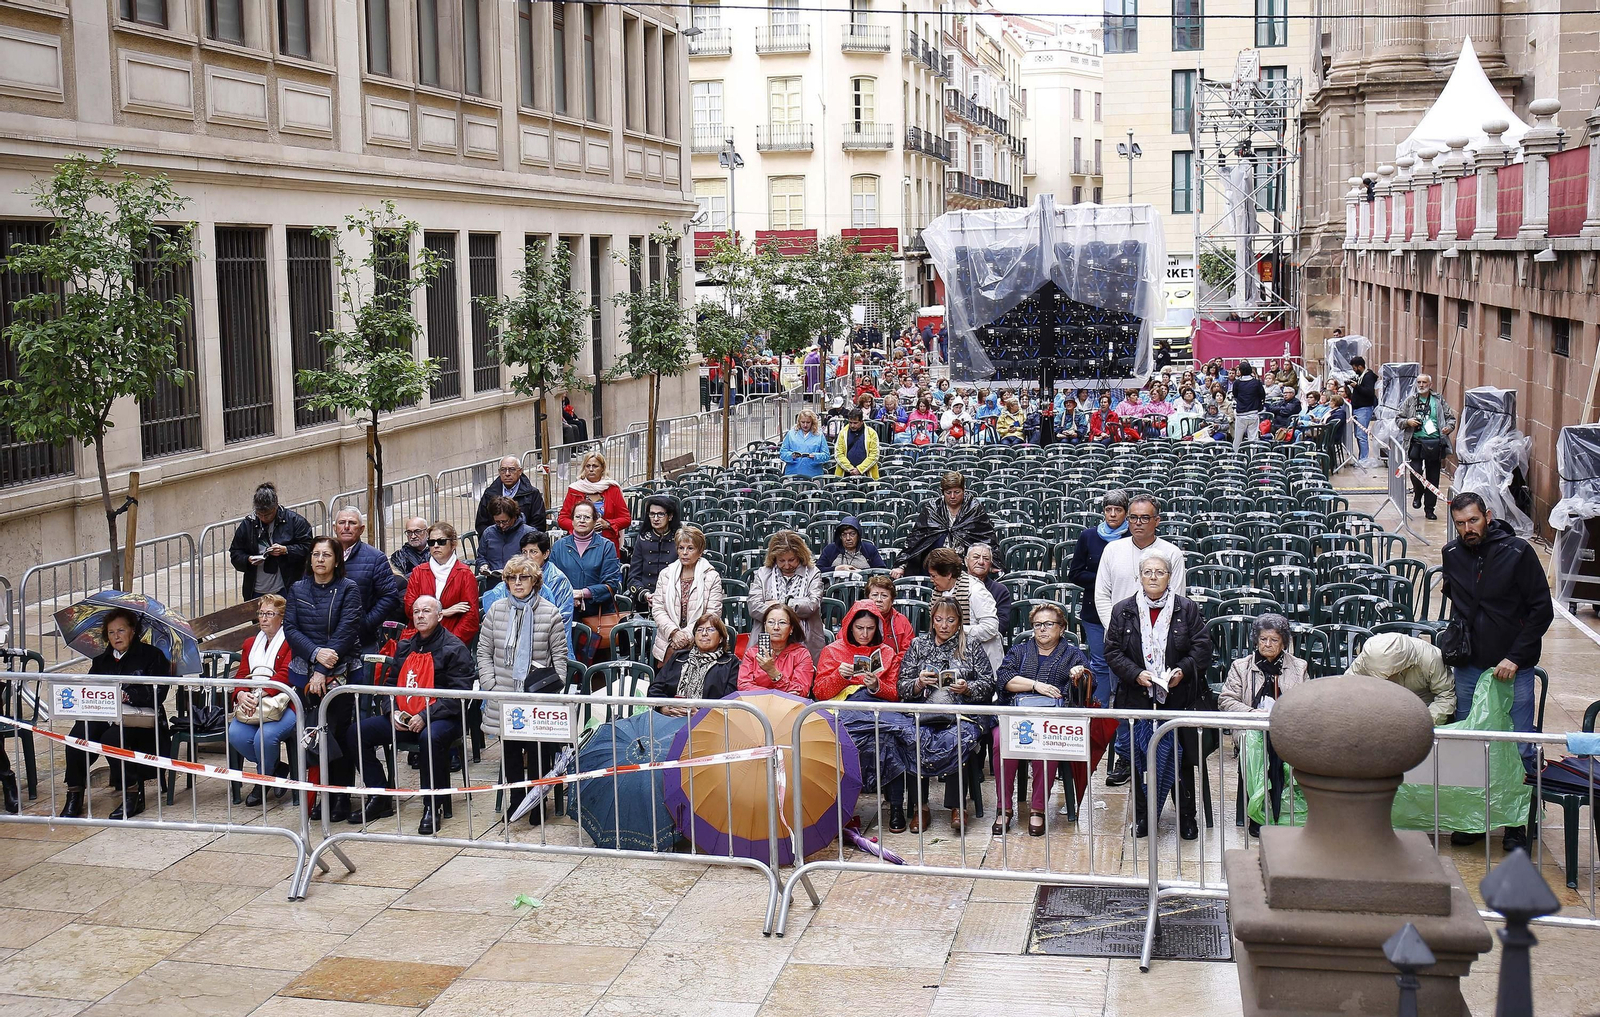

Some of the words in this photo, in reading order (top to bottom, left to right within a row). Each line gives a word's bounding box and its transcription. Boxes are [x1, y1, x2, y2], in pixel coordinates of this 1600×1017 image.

[1167, 268, 1194, 278] RKET
[81, 687, 115, 699] fersa
[532, 707, 568, 720] fersa
[1043, 720, 1084, 735] fersa
